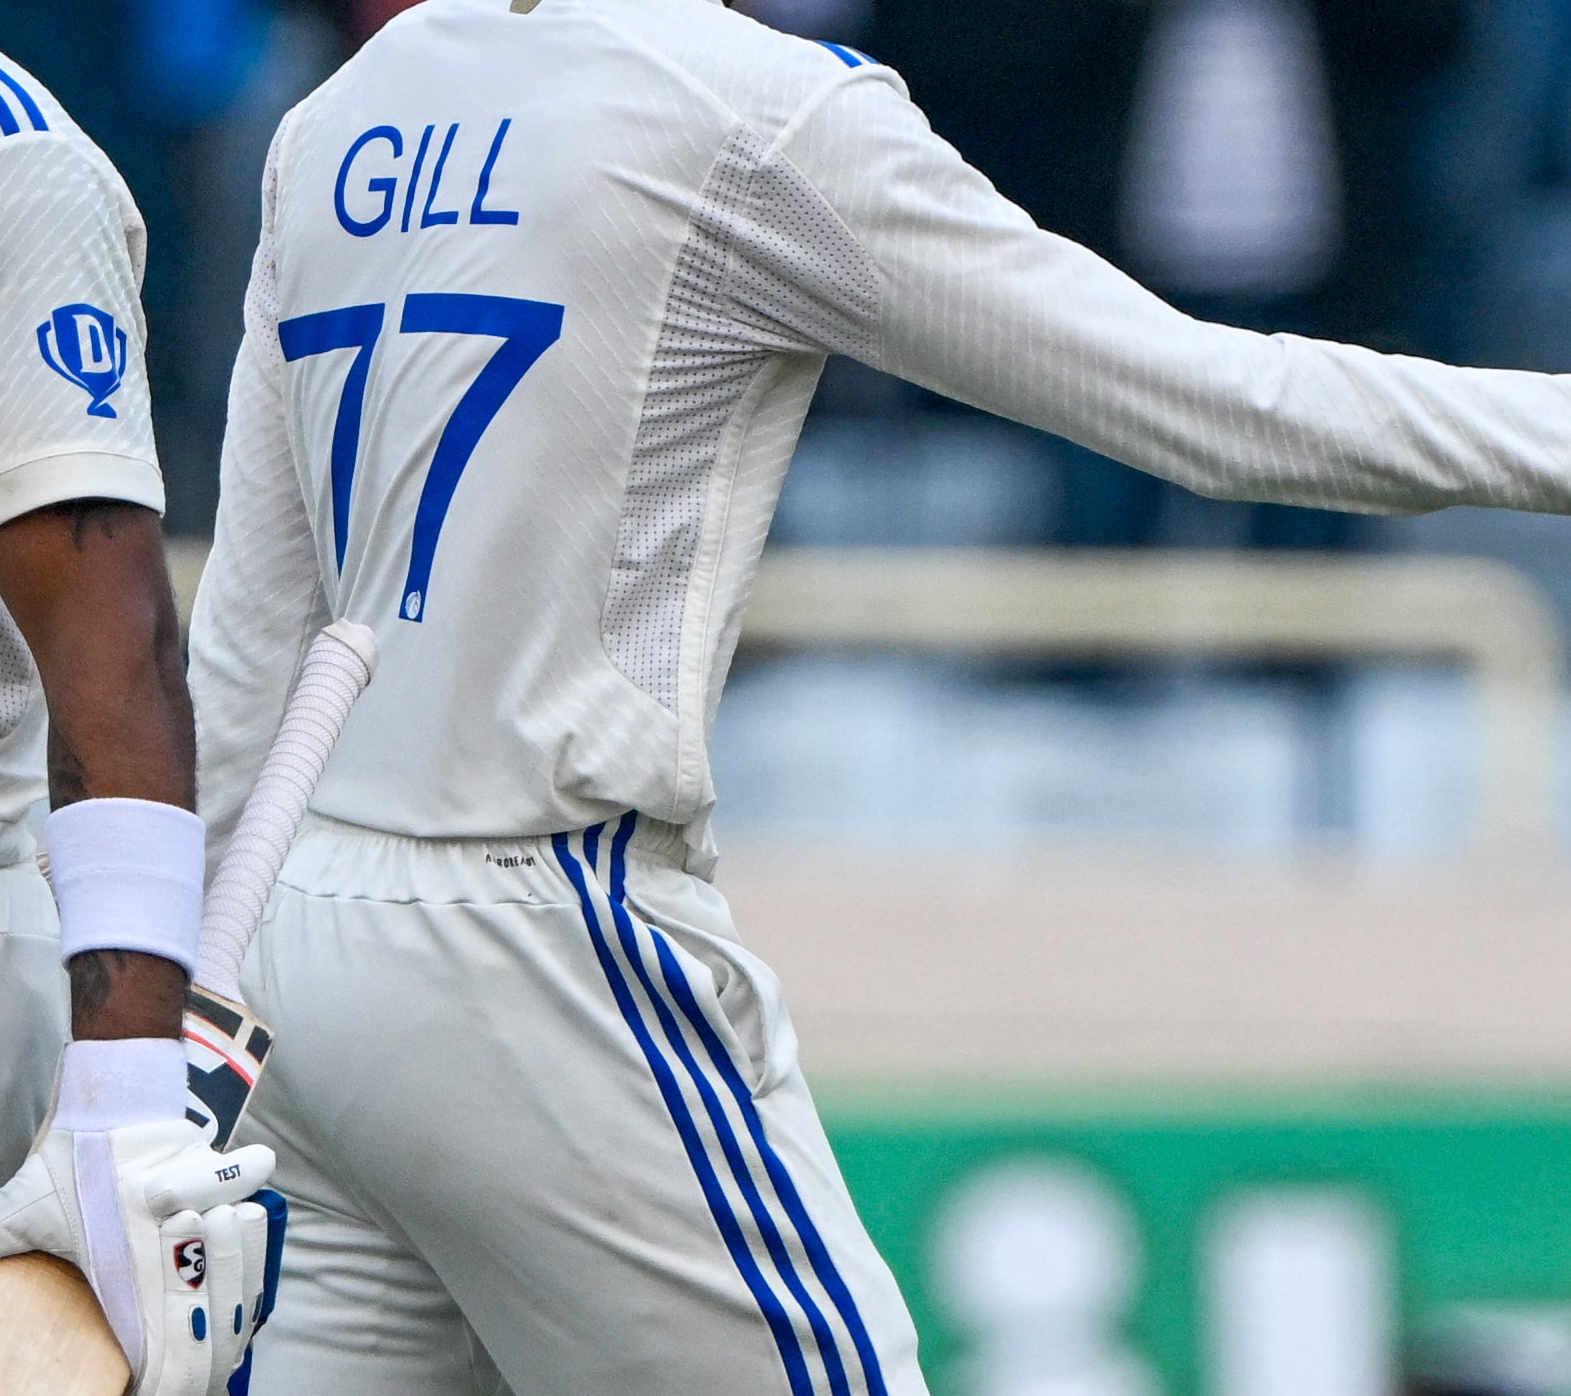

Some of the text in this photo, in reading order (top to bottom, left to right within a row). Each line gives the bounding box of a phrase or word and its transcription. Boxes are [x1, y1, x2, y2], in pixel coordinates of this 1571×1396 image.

[334, 118, 519, 238] GILL
[278, 293, 566, 623] 77
[214, 1163, 241, 1182] TEST
